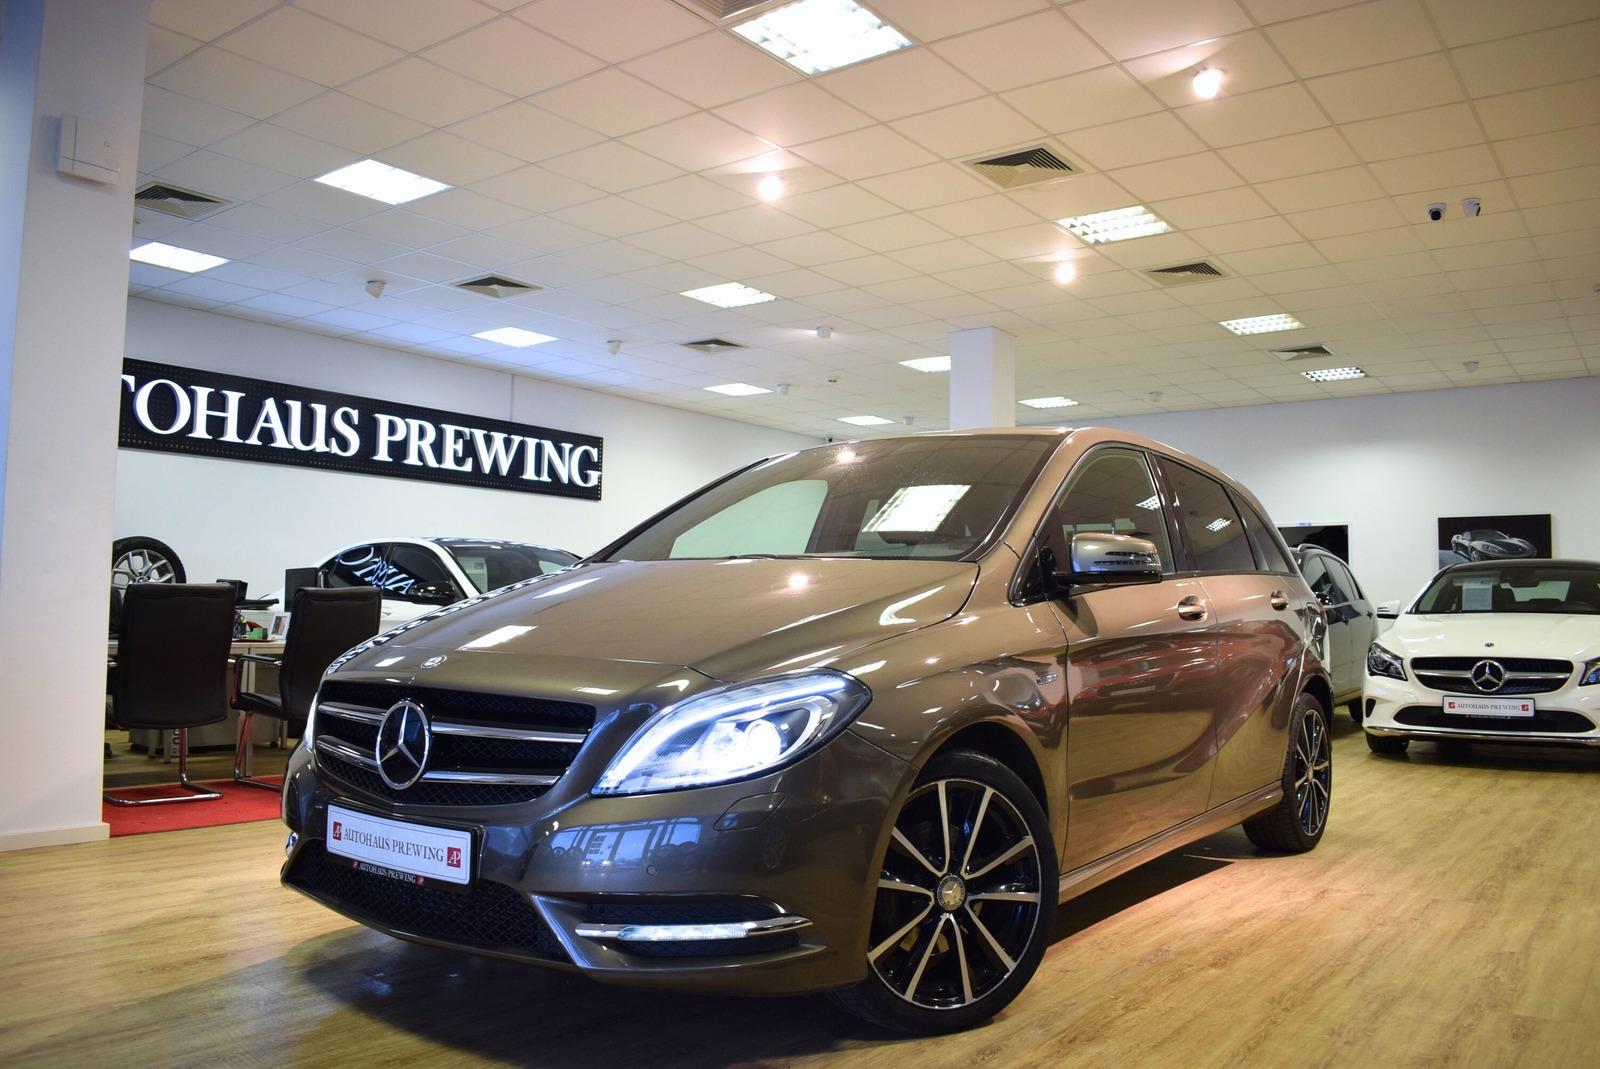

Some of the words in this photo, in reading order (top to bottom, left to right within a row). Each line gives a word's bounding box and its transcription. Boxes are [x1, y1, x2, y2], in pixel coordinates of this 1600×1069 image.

[121, 374, 361, 458] OHAUS
[370, 413, 602, 488] PREWING
[1457, 702, 1490, 710] AUTOHAUS
[343, 828, 390, 851] AUTOHAUS
[392, 839, 444, 862] PREWING
[358, 862, 387, 876] AUTOHAUS
[387, 869, 416, 884] PREWING
